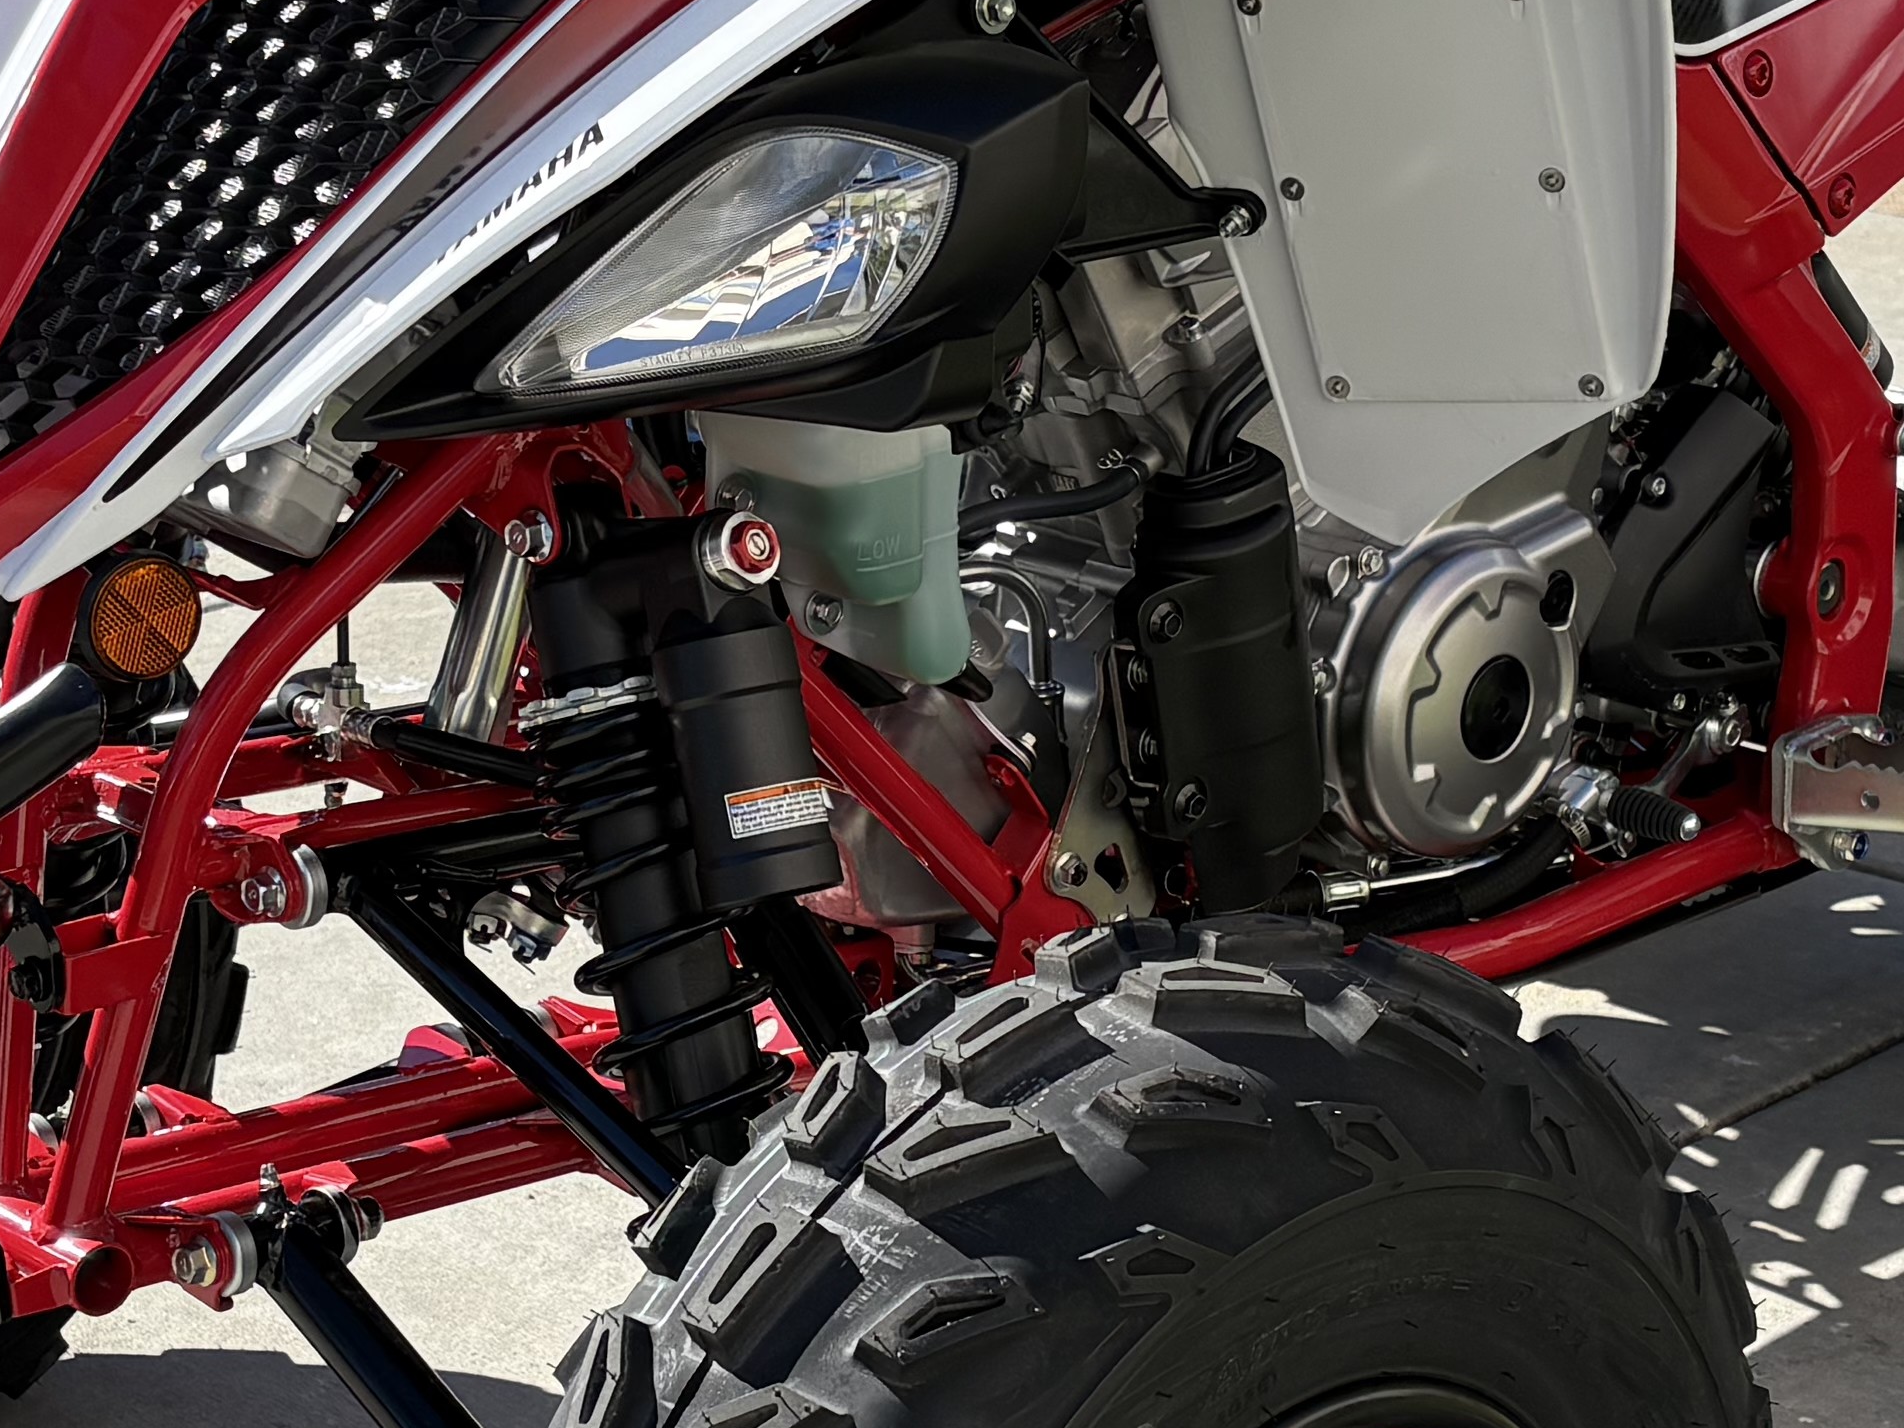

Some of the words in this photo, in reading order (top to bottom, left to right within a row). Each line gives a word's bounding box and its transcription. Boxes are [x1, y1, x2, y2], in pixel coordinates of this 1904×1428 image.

[437, 121, 604, 265] MAHA
[639, 350, 694, 368] STANLEY
[857, 533, 900, 561] LOW
